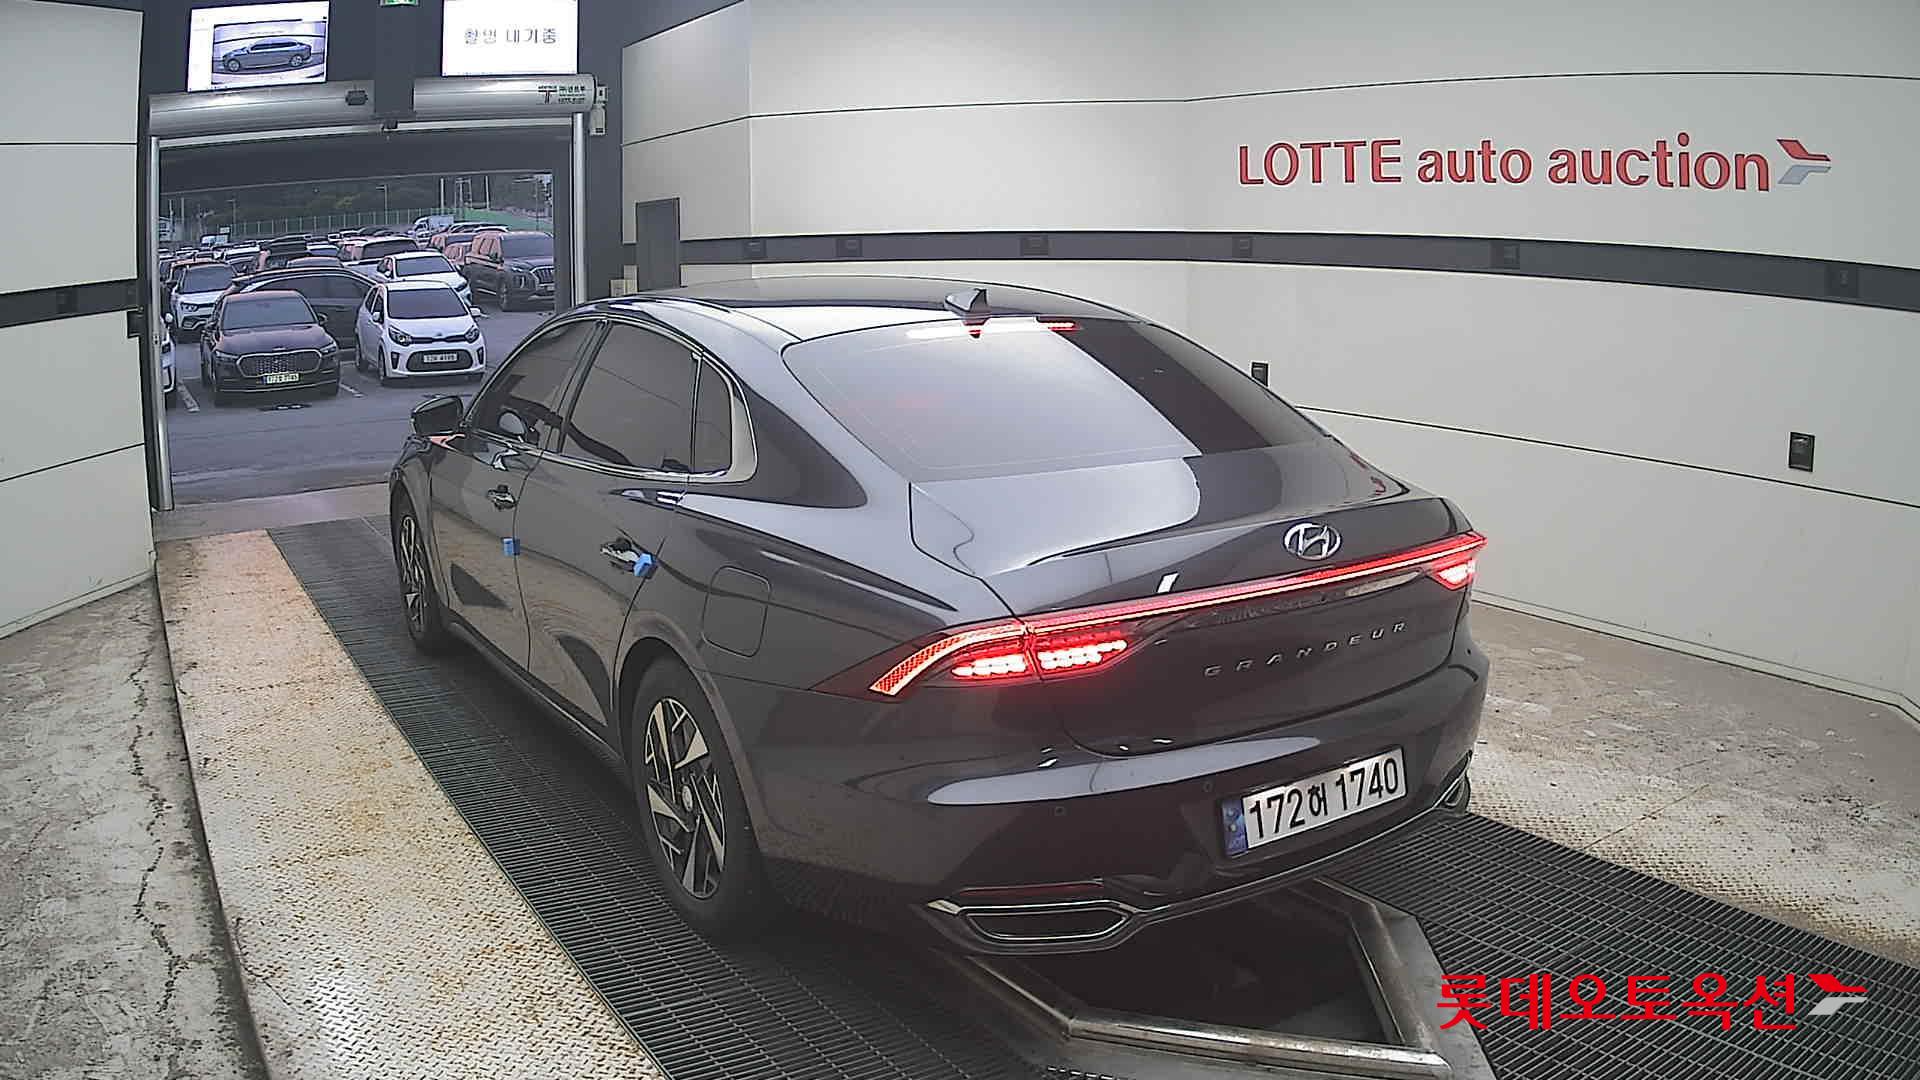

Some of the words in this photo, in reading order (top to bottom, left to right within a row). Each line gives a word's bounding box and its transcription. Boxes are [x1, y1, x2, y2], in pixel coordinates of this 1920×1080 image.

[1239, 139, 1402, 186] LOTTE
[1417, 138, 1533, 187] auto
[1547, 132, 1771, 193] auction
[1203, 620, 1407, 678] GRANDEUR
